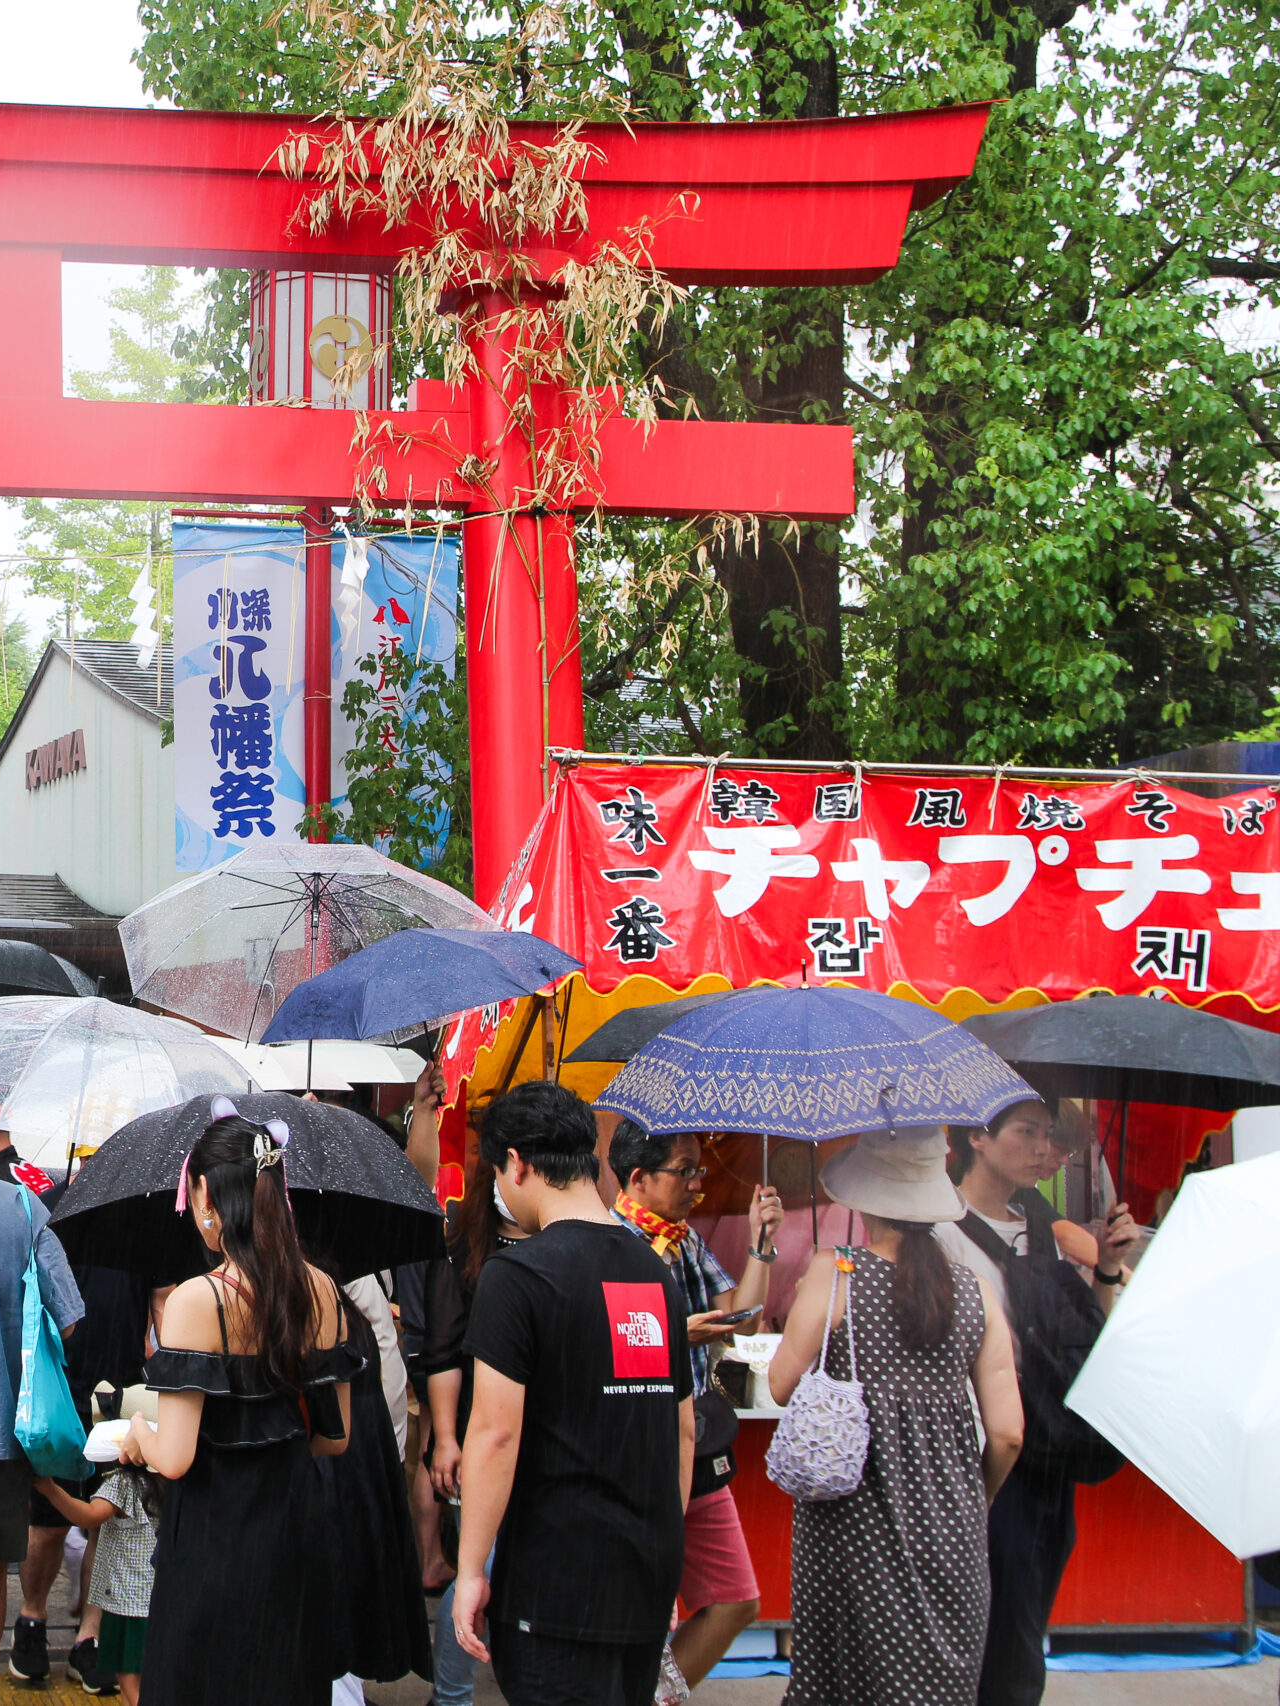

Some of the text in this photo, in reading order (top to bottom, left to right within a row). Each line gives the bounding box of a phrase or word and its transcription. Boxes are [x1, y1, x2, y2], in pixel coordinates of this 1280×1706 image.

[598, 786, 677, 964] 味一番
[627, 1311, 647, 1324] THE
[616, 1323, 648, 1335] NORTH
[627, 1334, 650, 1347] FACE
[603, 1385, 627, 1394] NEVER
[629, 1385, 644, 1393] STOP
